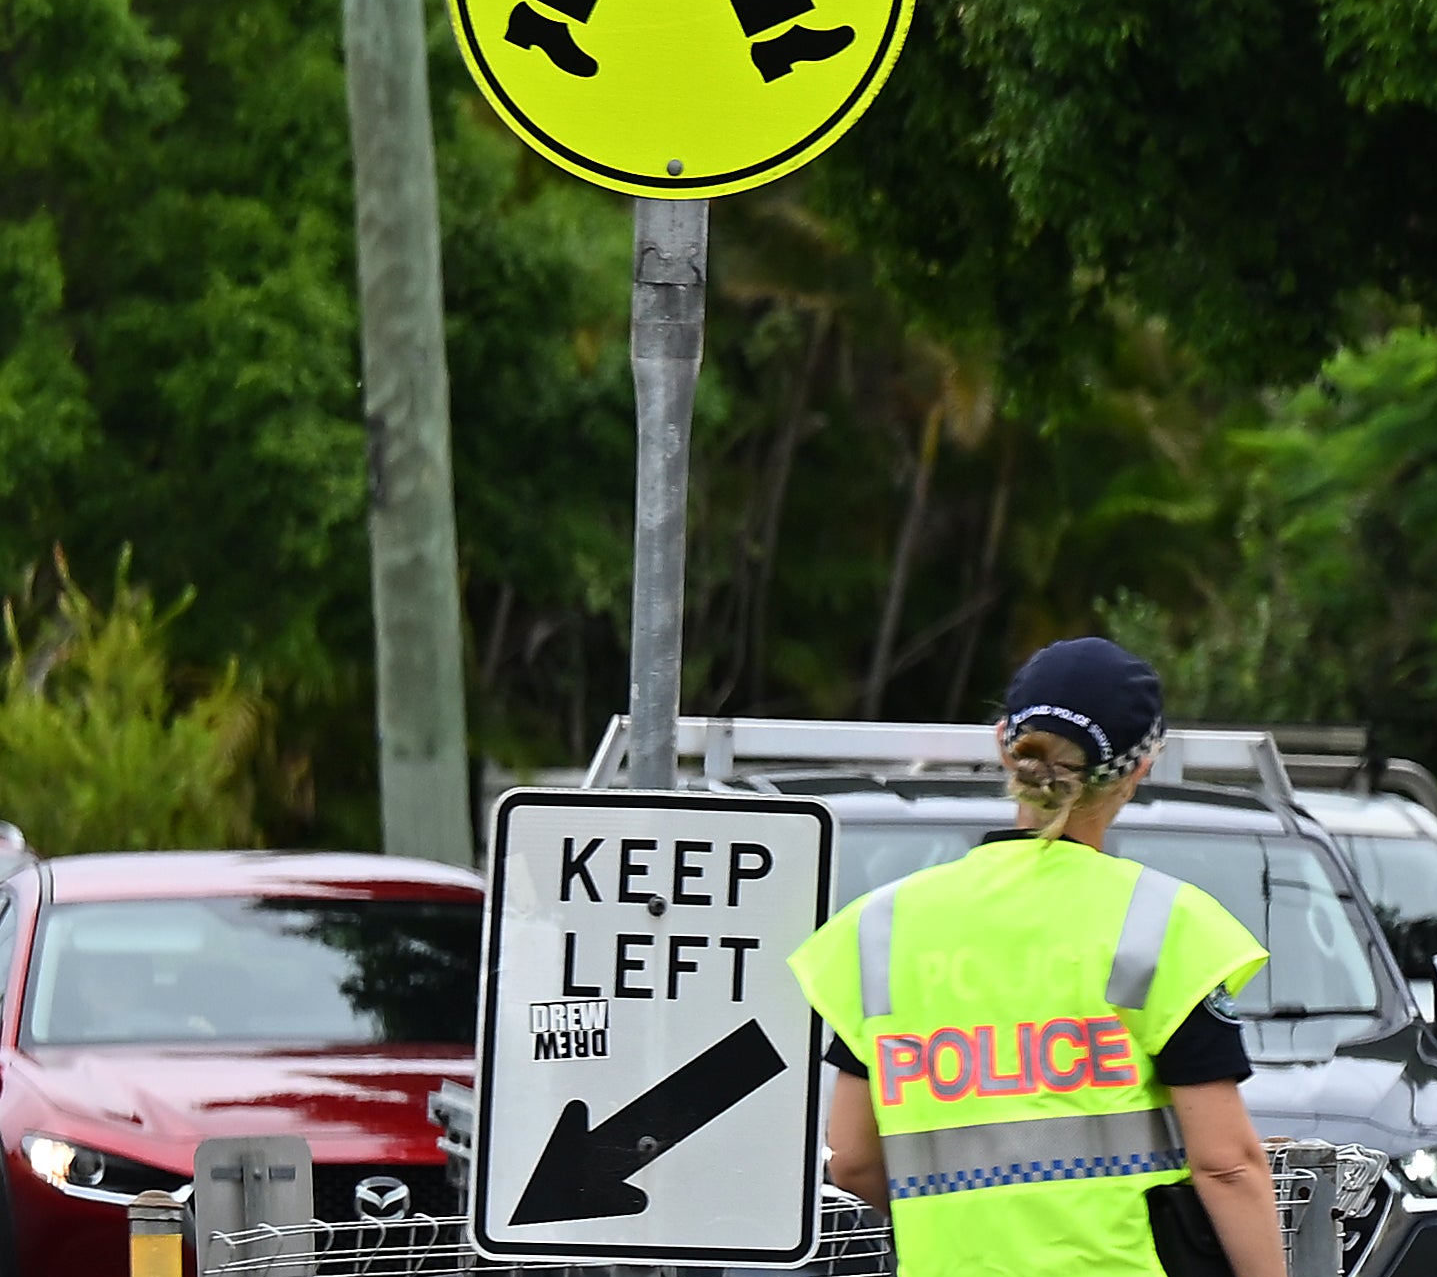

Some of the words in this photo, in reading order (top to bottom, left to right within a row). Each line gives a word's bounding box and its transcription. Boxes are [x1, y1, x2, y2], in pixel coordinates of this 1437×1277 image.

[560, 837, 774, 907] KEEP
[562, 932, 760, 1002] LEFT
[531, 1001, 607, 1032] DREW
[534, 1029, 608, 1060] DREW
[875, 1014, 1139, 1106] POLICE
